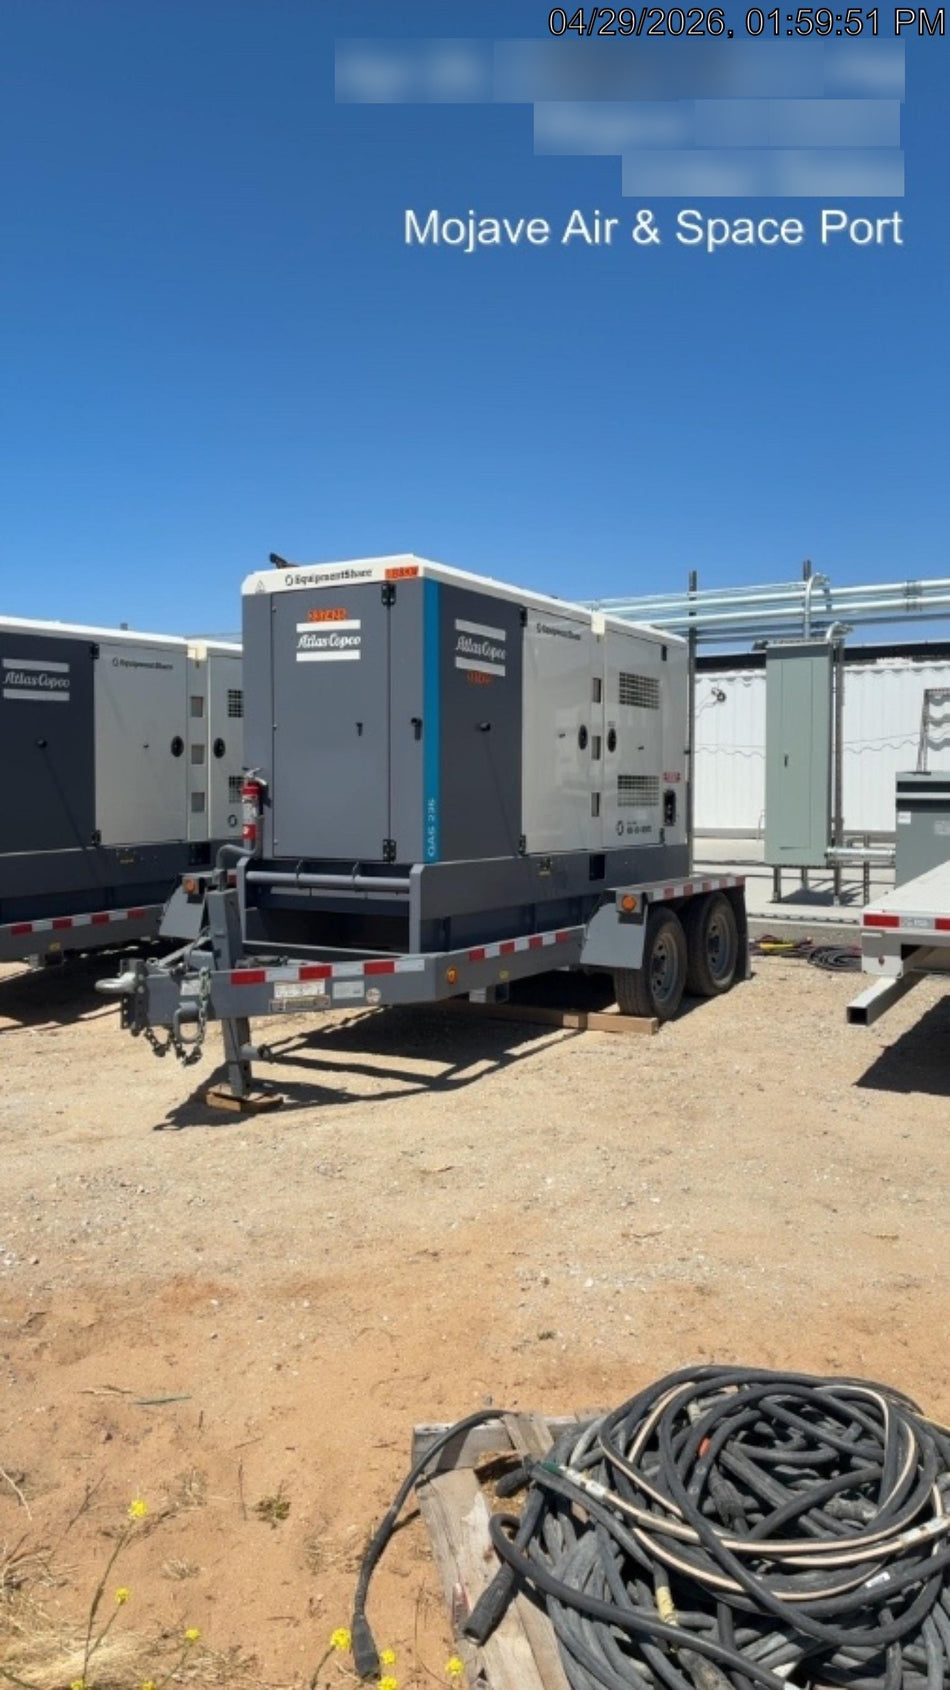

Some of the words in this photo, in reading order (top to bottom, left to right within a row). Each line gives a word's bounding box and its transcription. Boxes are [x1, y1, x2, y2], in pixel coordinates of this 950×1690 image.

[297, 633, 327, 648] Atlas
[328, 633, 361, 648] Copco
[456, 635, 482, 656] Atlas
[3, 671, 37, 686] Atlas
[38, 673, 70, 688] Copco
